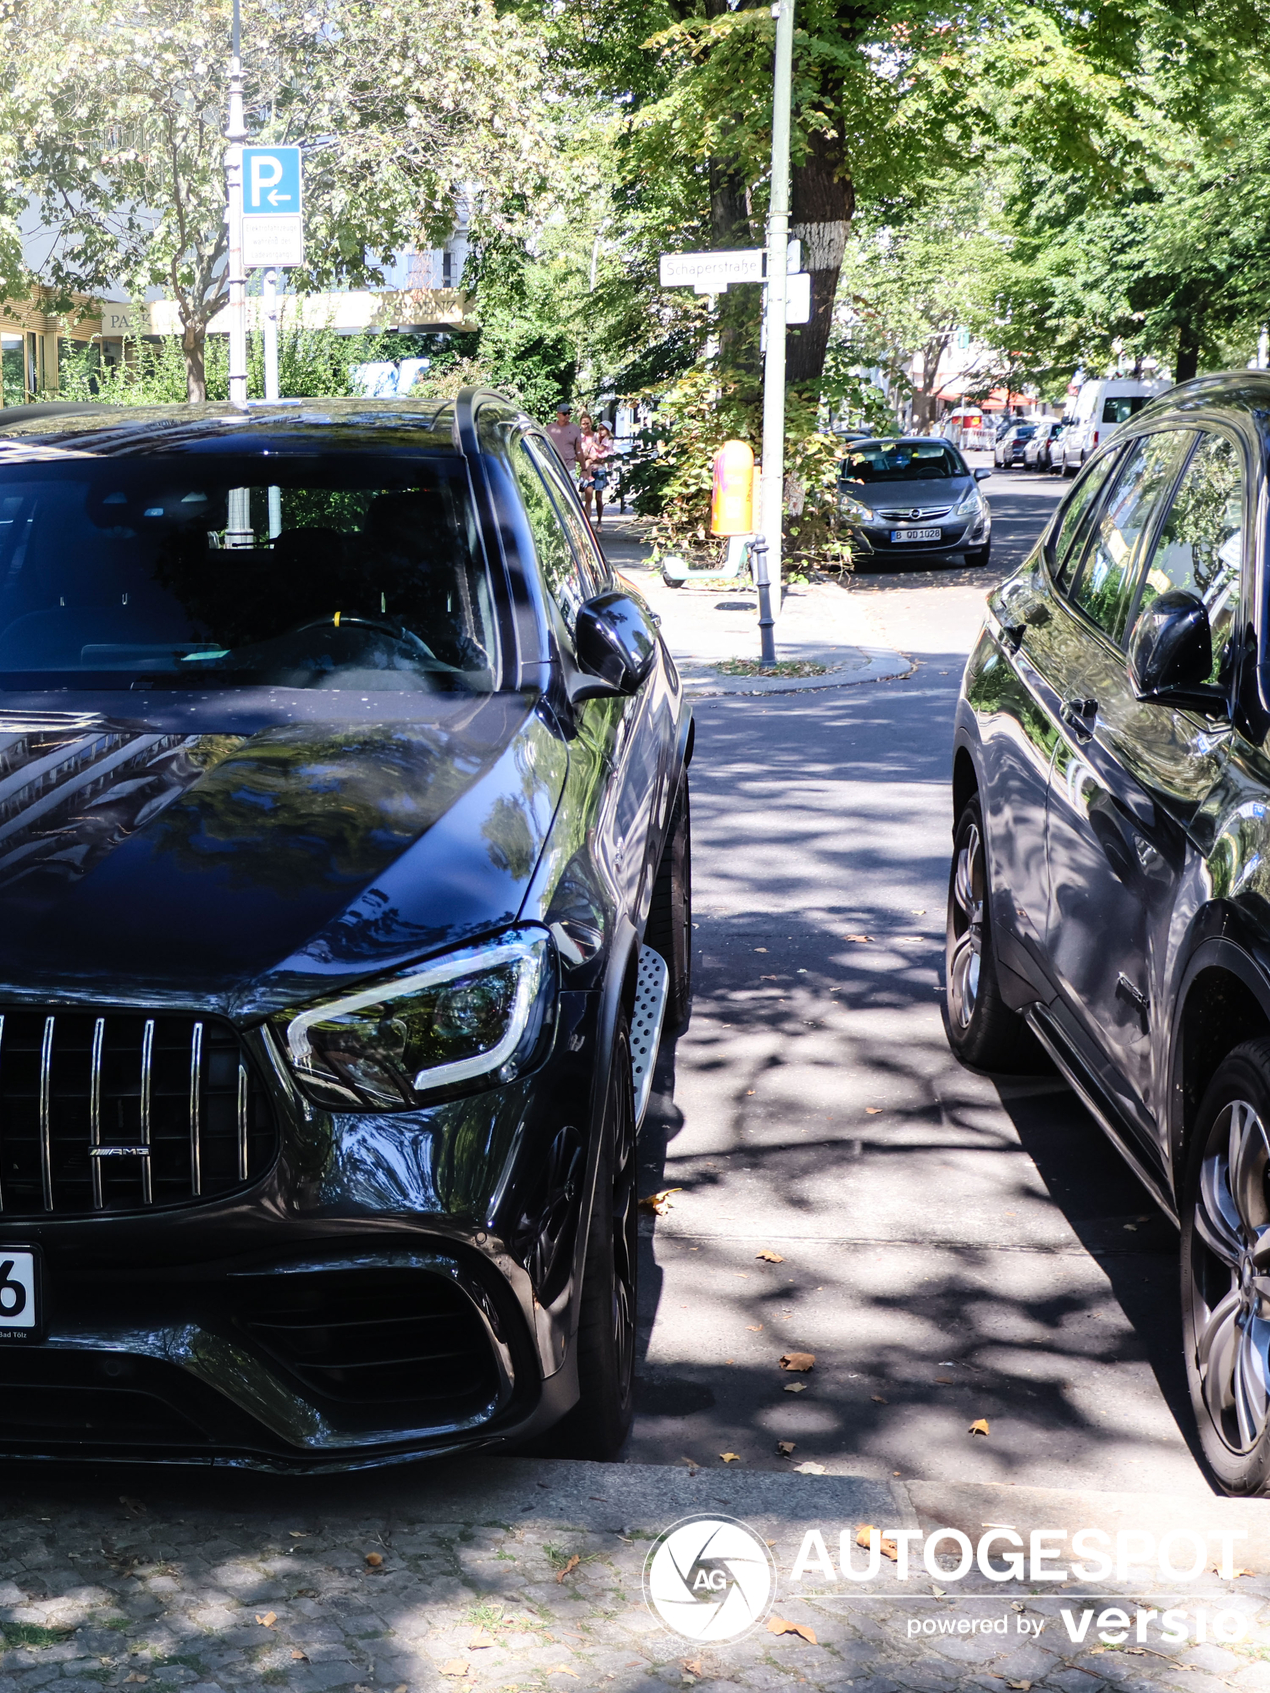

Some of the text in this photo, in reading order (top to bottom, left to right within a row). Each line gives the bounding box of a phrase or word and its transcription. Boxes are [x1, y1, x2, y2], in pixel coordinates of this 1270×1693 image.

[251, 156, 283, 206] P
[246, 223, 298, 234] Elektrofahrzeuge
[251, 251, 293, 261] Ladevorgangs
[666, 258, 758, 278] Schaperstraße
[109, 1148, 149, 1156] AMG
